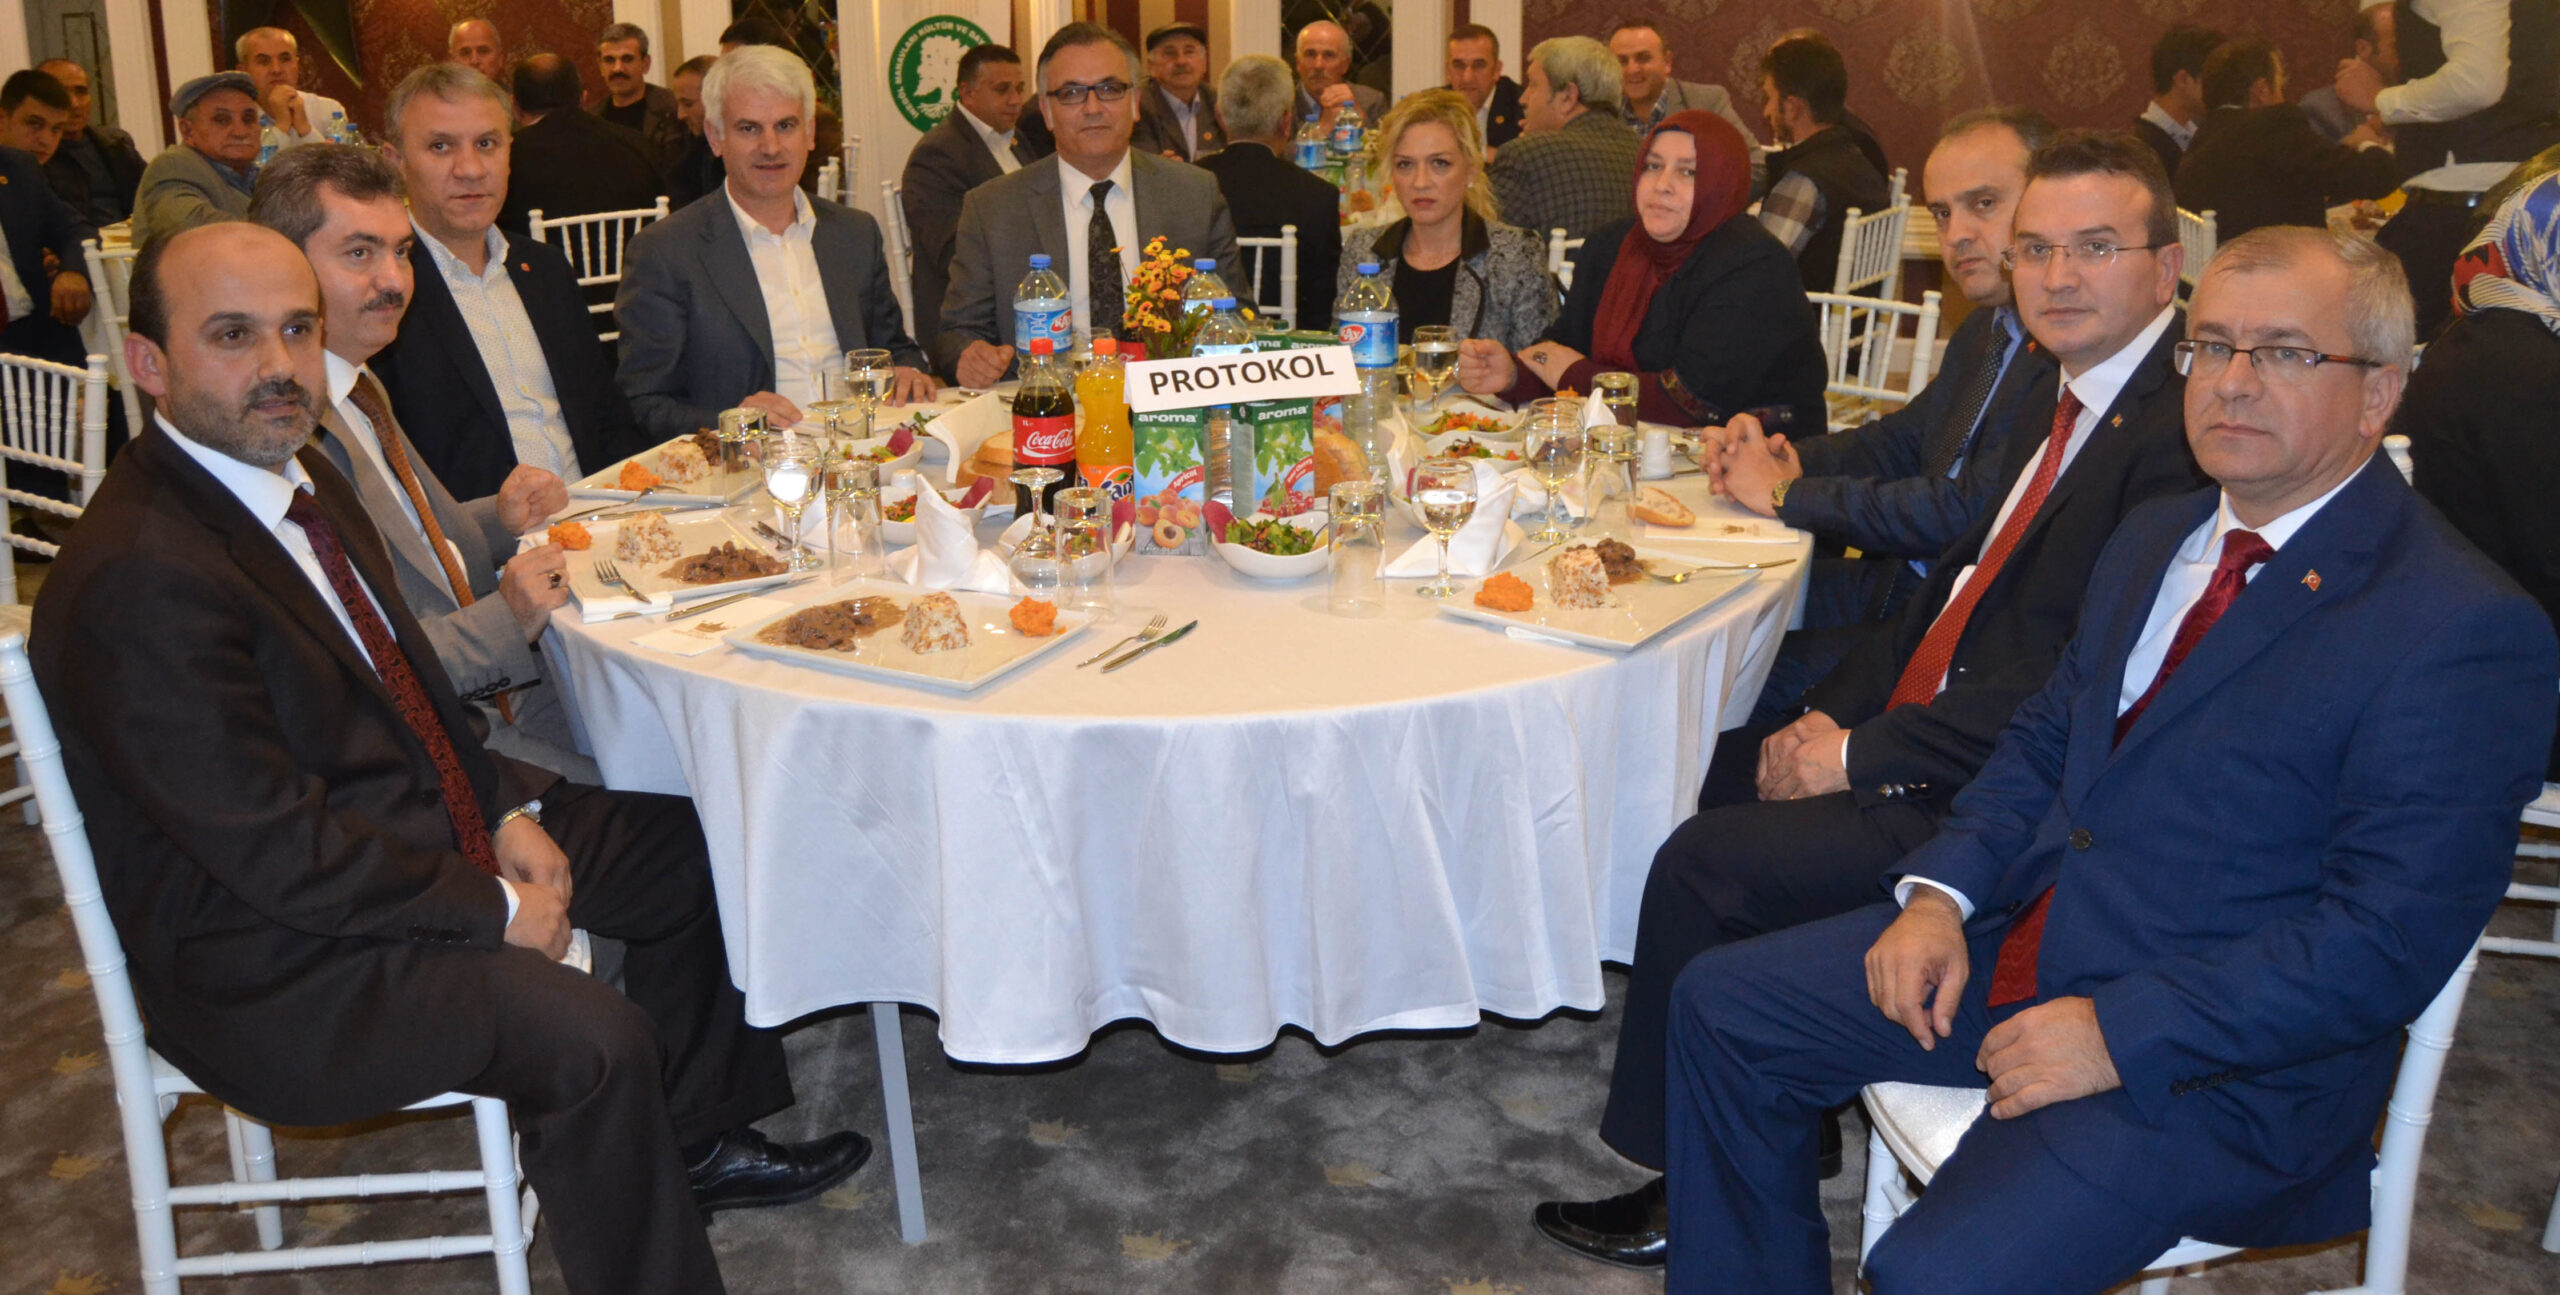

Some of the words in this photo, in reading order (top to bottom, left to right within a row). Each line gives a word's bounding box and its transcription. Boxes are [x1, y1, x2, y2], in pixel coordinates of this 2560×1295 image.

[895, 33, 919, 84] MANAVLARI
[918, 21, 954, 36] KÜLTÜR
[956, 23, 968, 34] VE
[1149, 353, 1334, 395] PROTOKOL
[1138, 413, 1196, 423] aroma
[1257, 405, 1308, 421] aroma
[1026, 428, 1073, 449] Coca-Cola
[1173, 469, 1197, 488] Apricot
